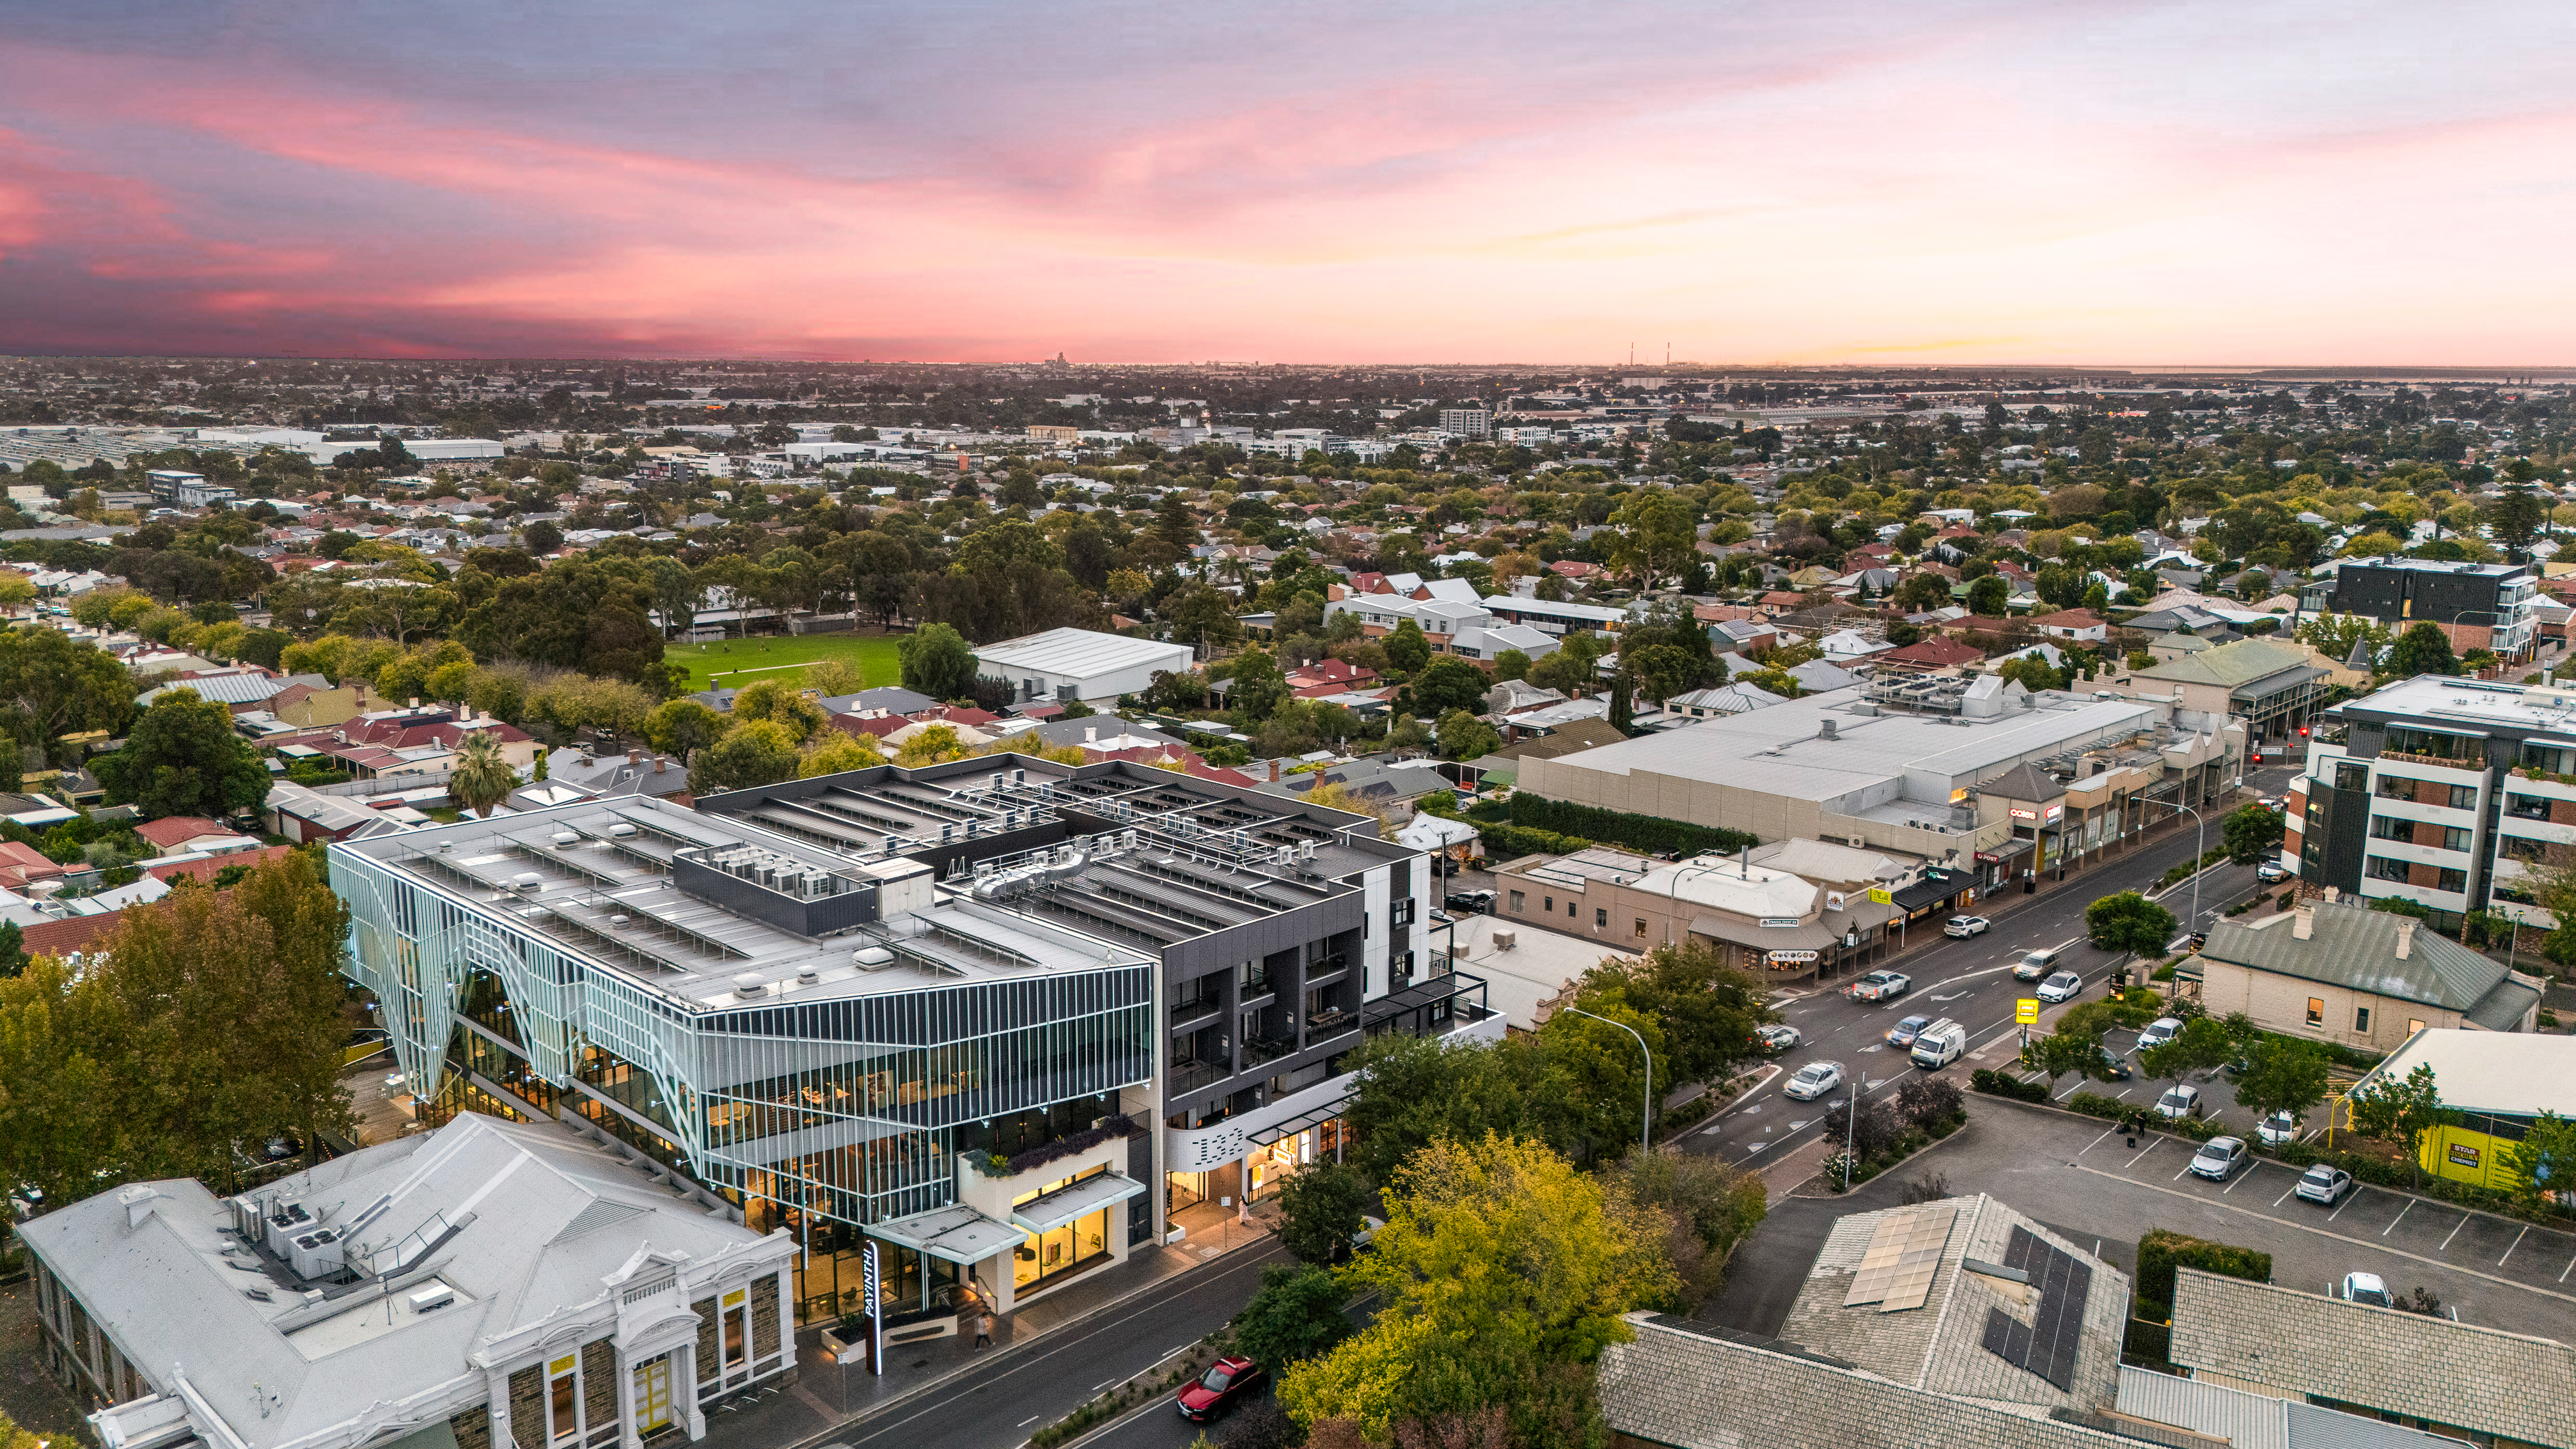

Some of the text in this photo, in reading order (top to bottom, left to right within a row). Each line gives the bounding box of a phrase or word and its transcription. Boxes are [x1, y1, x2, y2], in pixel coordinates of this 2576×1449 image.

[2010, 809, 2036, 820] coles
[1873, 890, 1889, 901] Melt
[1192, 1128, 1243, 1165] 132
[2454, 1145, 2476, 1155] STAR
[2450, 1156, 2477, 1167] CHEMIST
[863, 1248, 874, 1317] PAYINTHI
